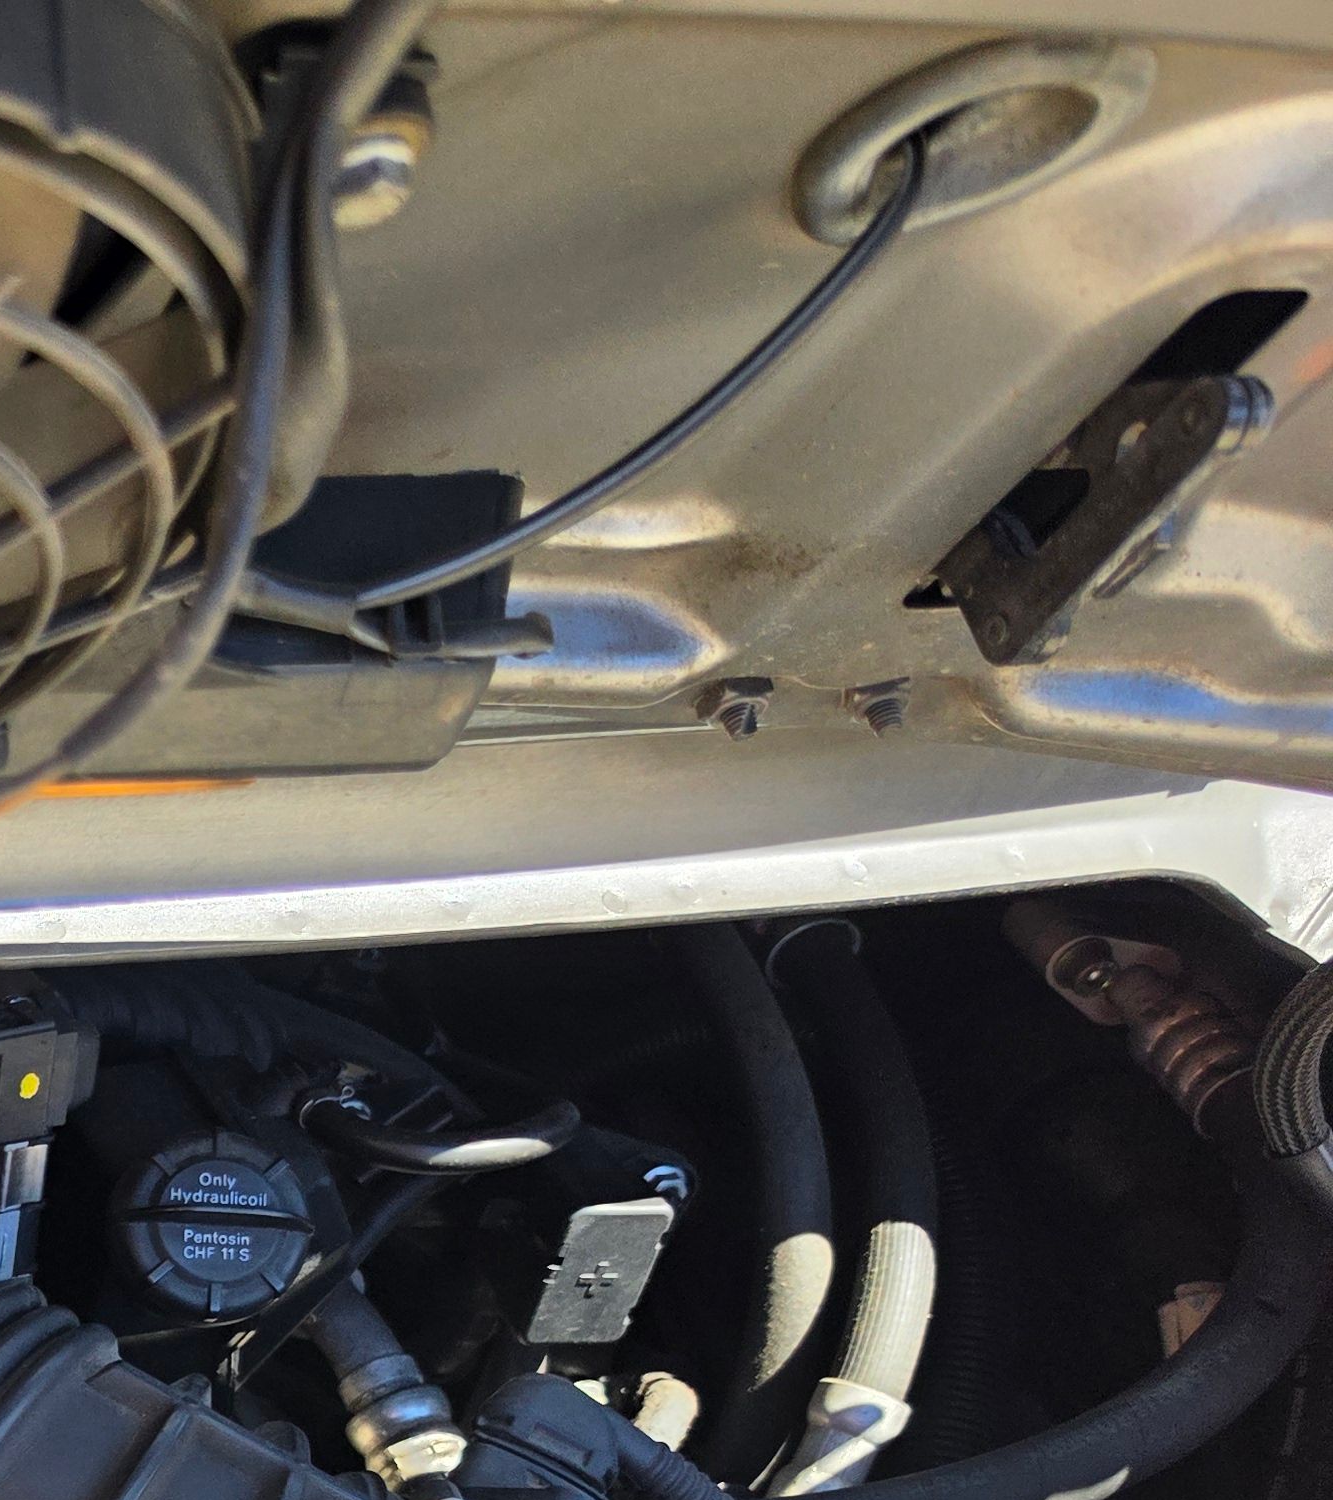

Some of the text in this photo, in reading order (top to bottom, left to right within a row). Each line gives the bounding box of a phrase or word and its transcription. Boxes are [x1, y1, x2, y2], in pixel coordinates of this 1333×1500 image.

[199, 1172, 236, 1190] Only
[170, 1187, 267, 1206] Hydraulicoil
[184, 1228, 250, 1245] Pentosin
[183, 1245, 250, 1261] CHF 11 S
